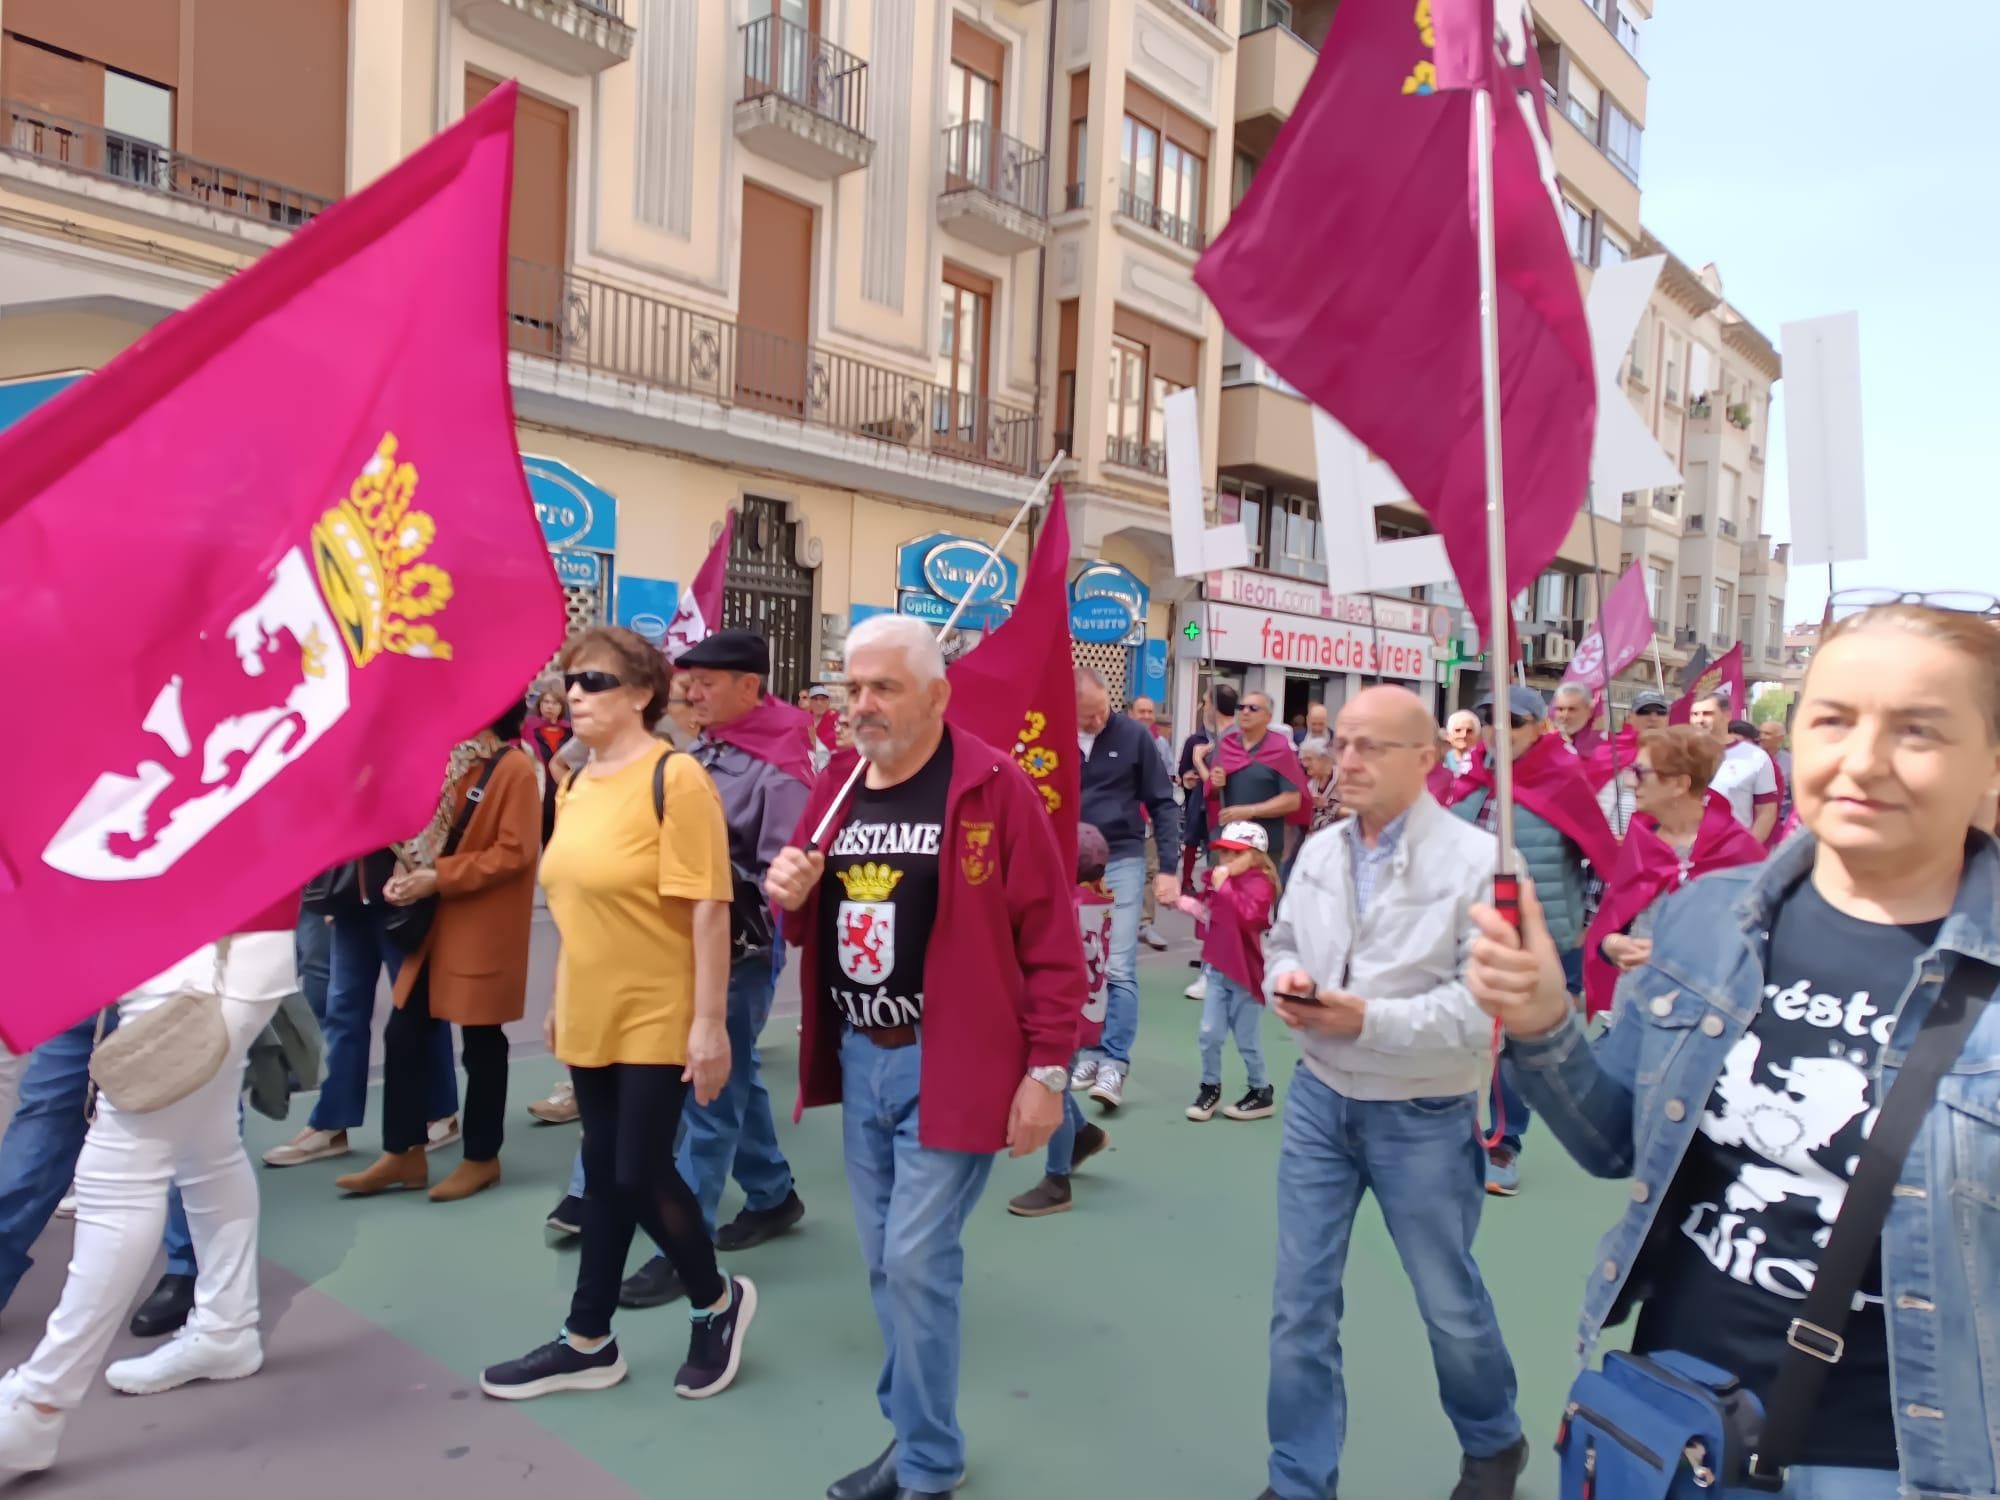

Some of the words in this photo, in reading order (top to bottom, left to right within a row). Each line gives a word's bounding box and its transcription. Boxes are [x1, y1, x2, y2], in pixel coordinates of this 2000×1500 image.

[936, 558, 998, 588] Navaro
[1072, 615, 1127, 630] Navarro
[1261, 617, 1364, 669] farmacia
[828, 819, 942, 856] RÉSTAME
